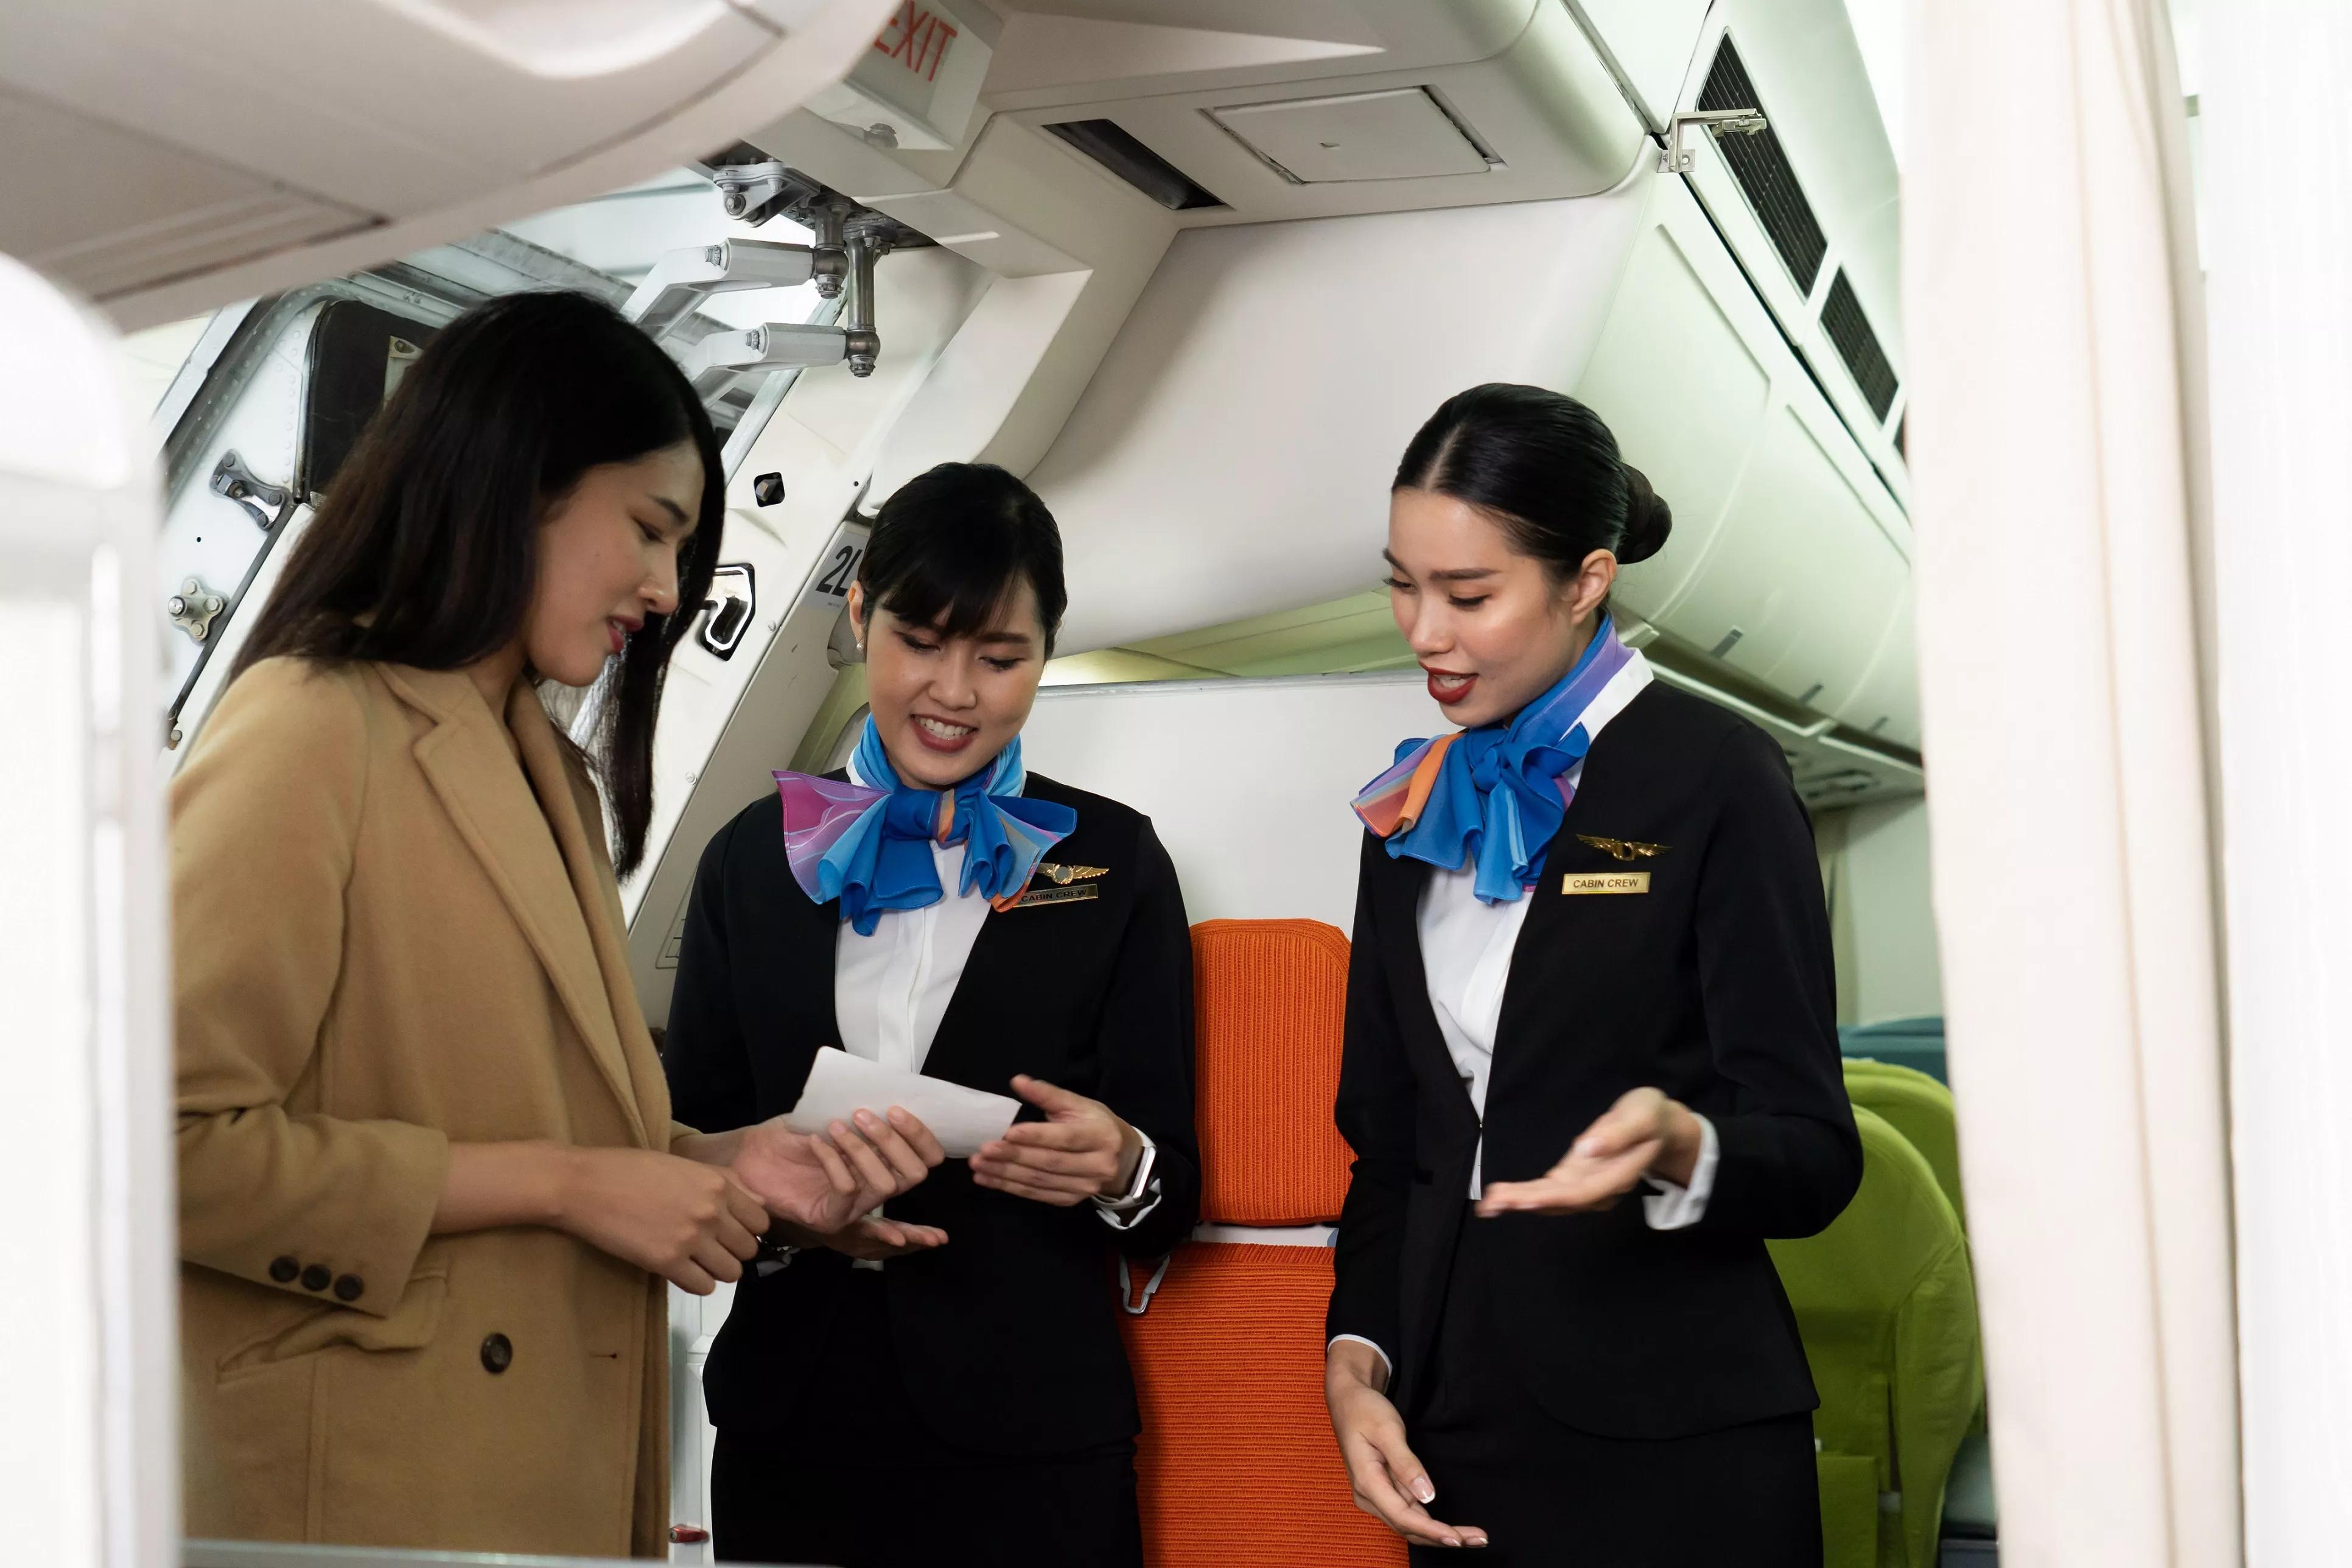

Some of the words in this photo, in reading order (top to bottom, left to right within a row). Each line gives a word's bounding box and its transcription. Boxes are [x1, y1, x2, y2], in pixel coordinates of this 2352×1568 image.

[815, 545, 863, 597] 2L
[1573, 880, 1604, 888] CABIN
[1607, 879, 1639, 887] CREW
[1021, 894, 1053, 902] CABIN
[1055, 889, 1087, 898] CREW
